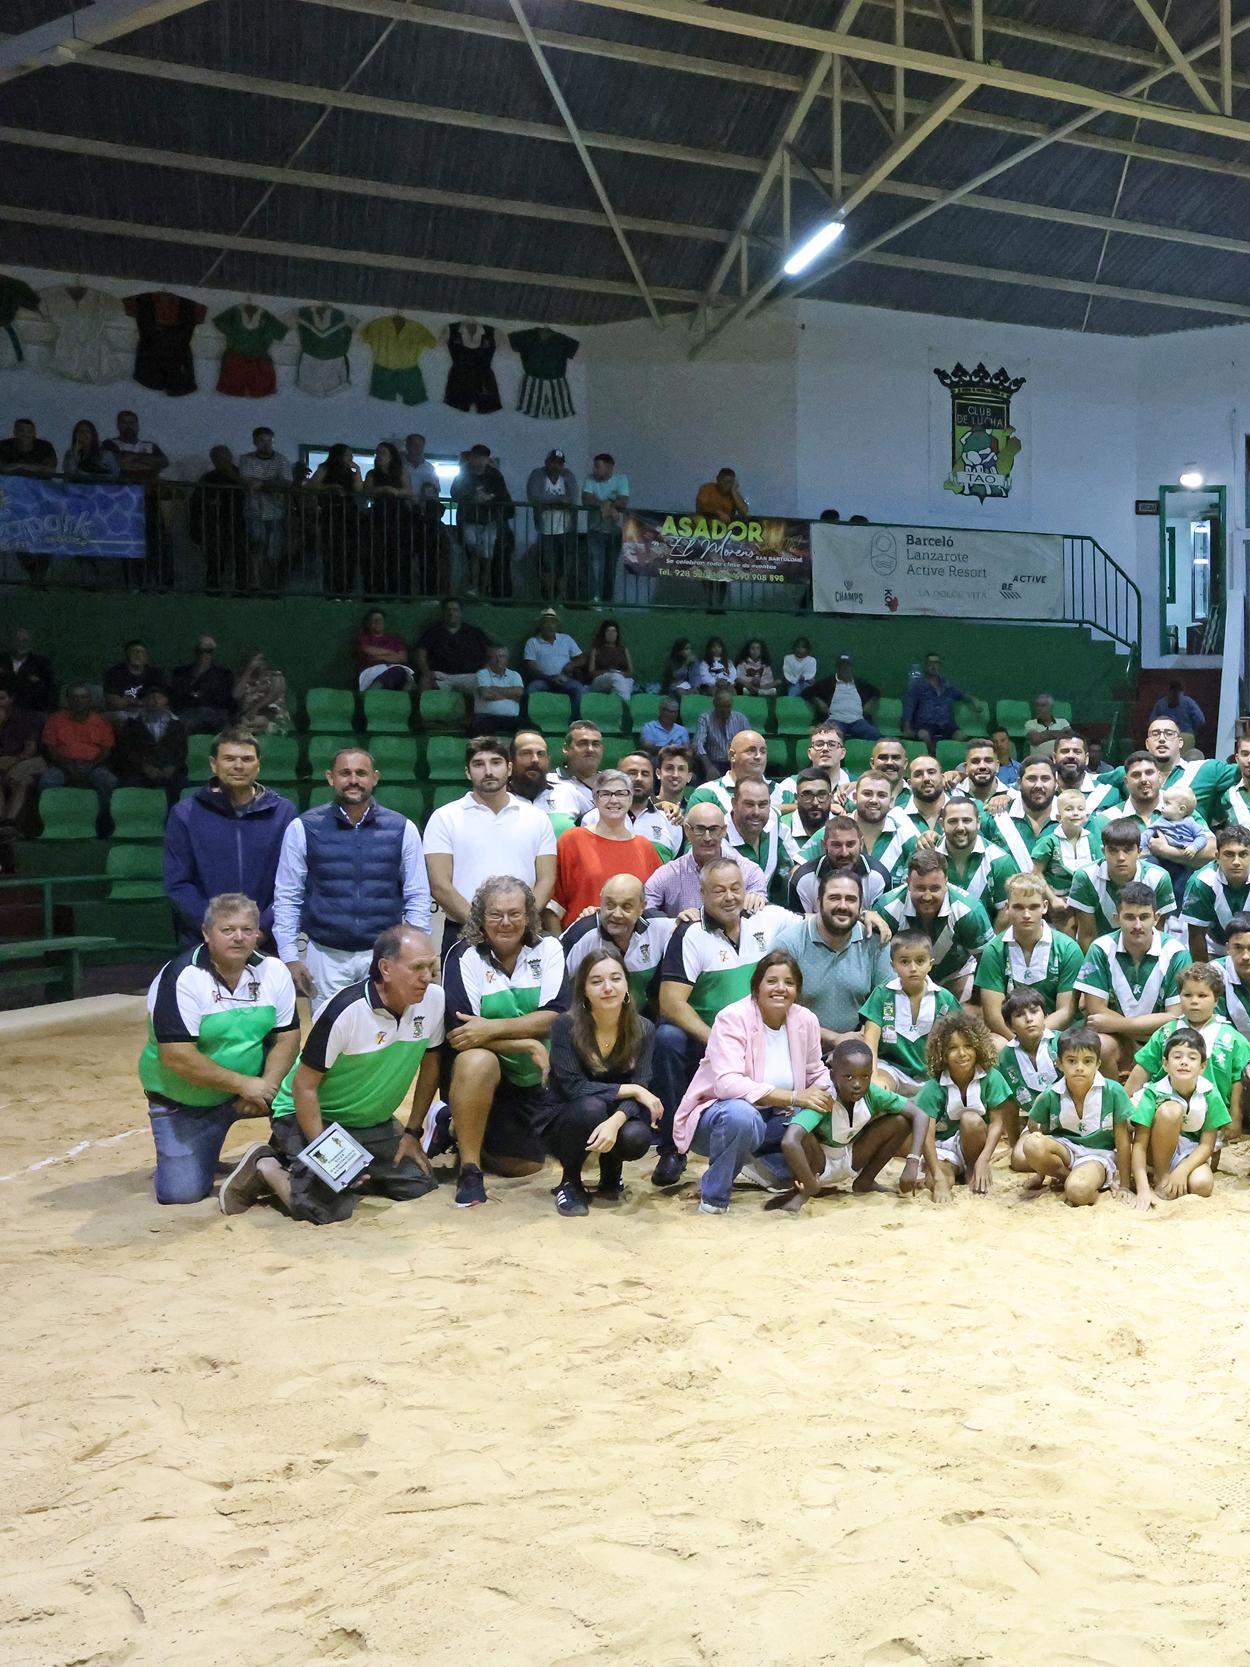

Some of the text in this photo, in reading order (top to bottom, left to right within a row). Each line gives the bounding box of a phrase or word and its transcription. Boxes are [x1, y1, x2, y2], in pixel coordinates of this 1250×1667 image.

[968, 405, 992, 416] CLUB
[957, 414, 1003, 427] DE LUCHA
[966, 473, 996, 484] TAO
[661, 515, 764, 542] ASADOR
[668, 530, 755, 560] El Moreno
[905, 534, 954, 548] Barceló
[906, 549, 969, 564] Lanzarote
[906, 564, 988, 579] Active Resort
[1012, 575, 1048, 585] ACTIVE
[834, 590, 864, 605] CHAMPS
